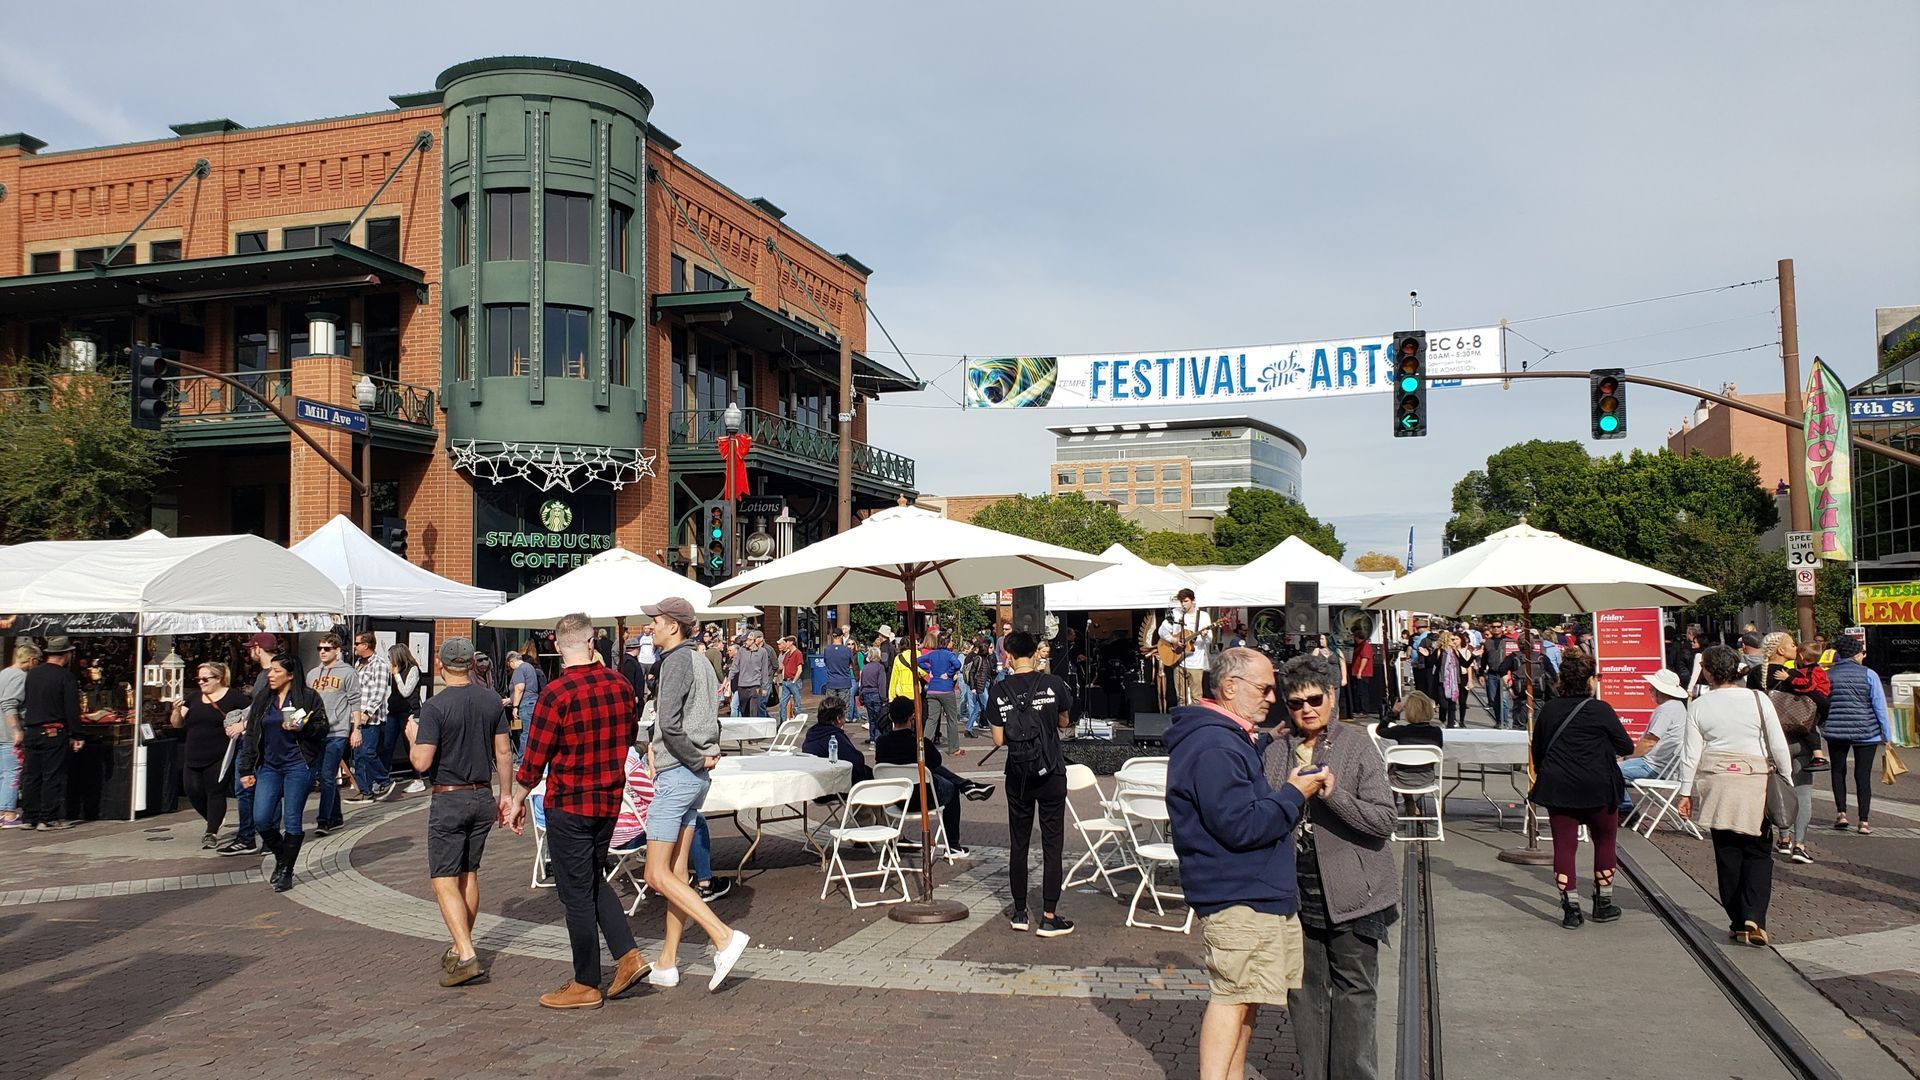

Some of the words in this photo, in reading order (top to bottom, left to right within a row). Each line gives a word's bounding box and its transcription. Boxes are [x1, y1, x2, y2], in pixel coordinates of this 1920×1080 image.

[1430, 337, 1451, 352] EC
[1456, 335, 1482, 350] 6-8
[1089, 354, 1257, 401] FESTIVAL
[1277, 350, 1298, 371] of
[1058, 379, 1087, 388] TEMPE
[1892, 401, 1914, 413] St
[304, 405, 329, 420] Mill
[332, 411, 351, 425] Ave
[738, 500, 780, 512] Lotions
[485, 531, 611, 549] STARBUCKS
[1791, 552, 1817, 564] 30
[1600, 614, 1625, 622] friday
[1602, 665, 1637, 673] saturday
[312, 676, 341, 690] ASU
[1619, 716, 1634, 724] day
